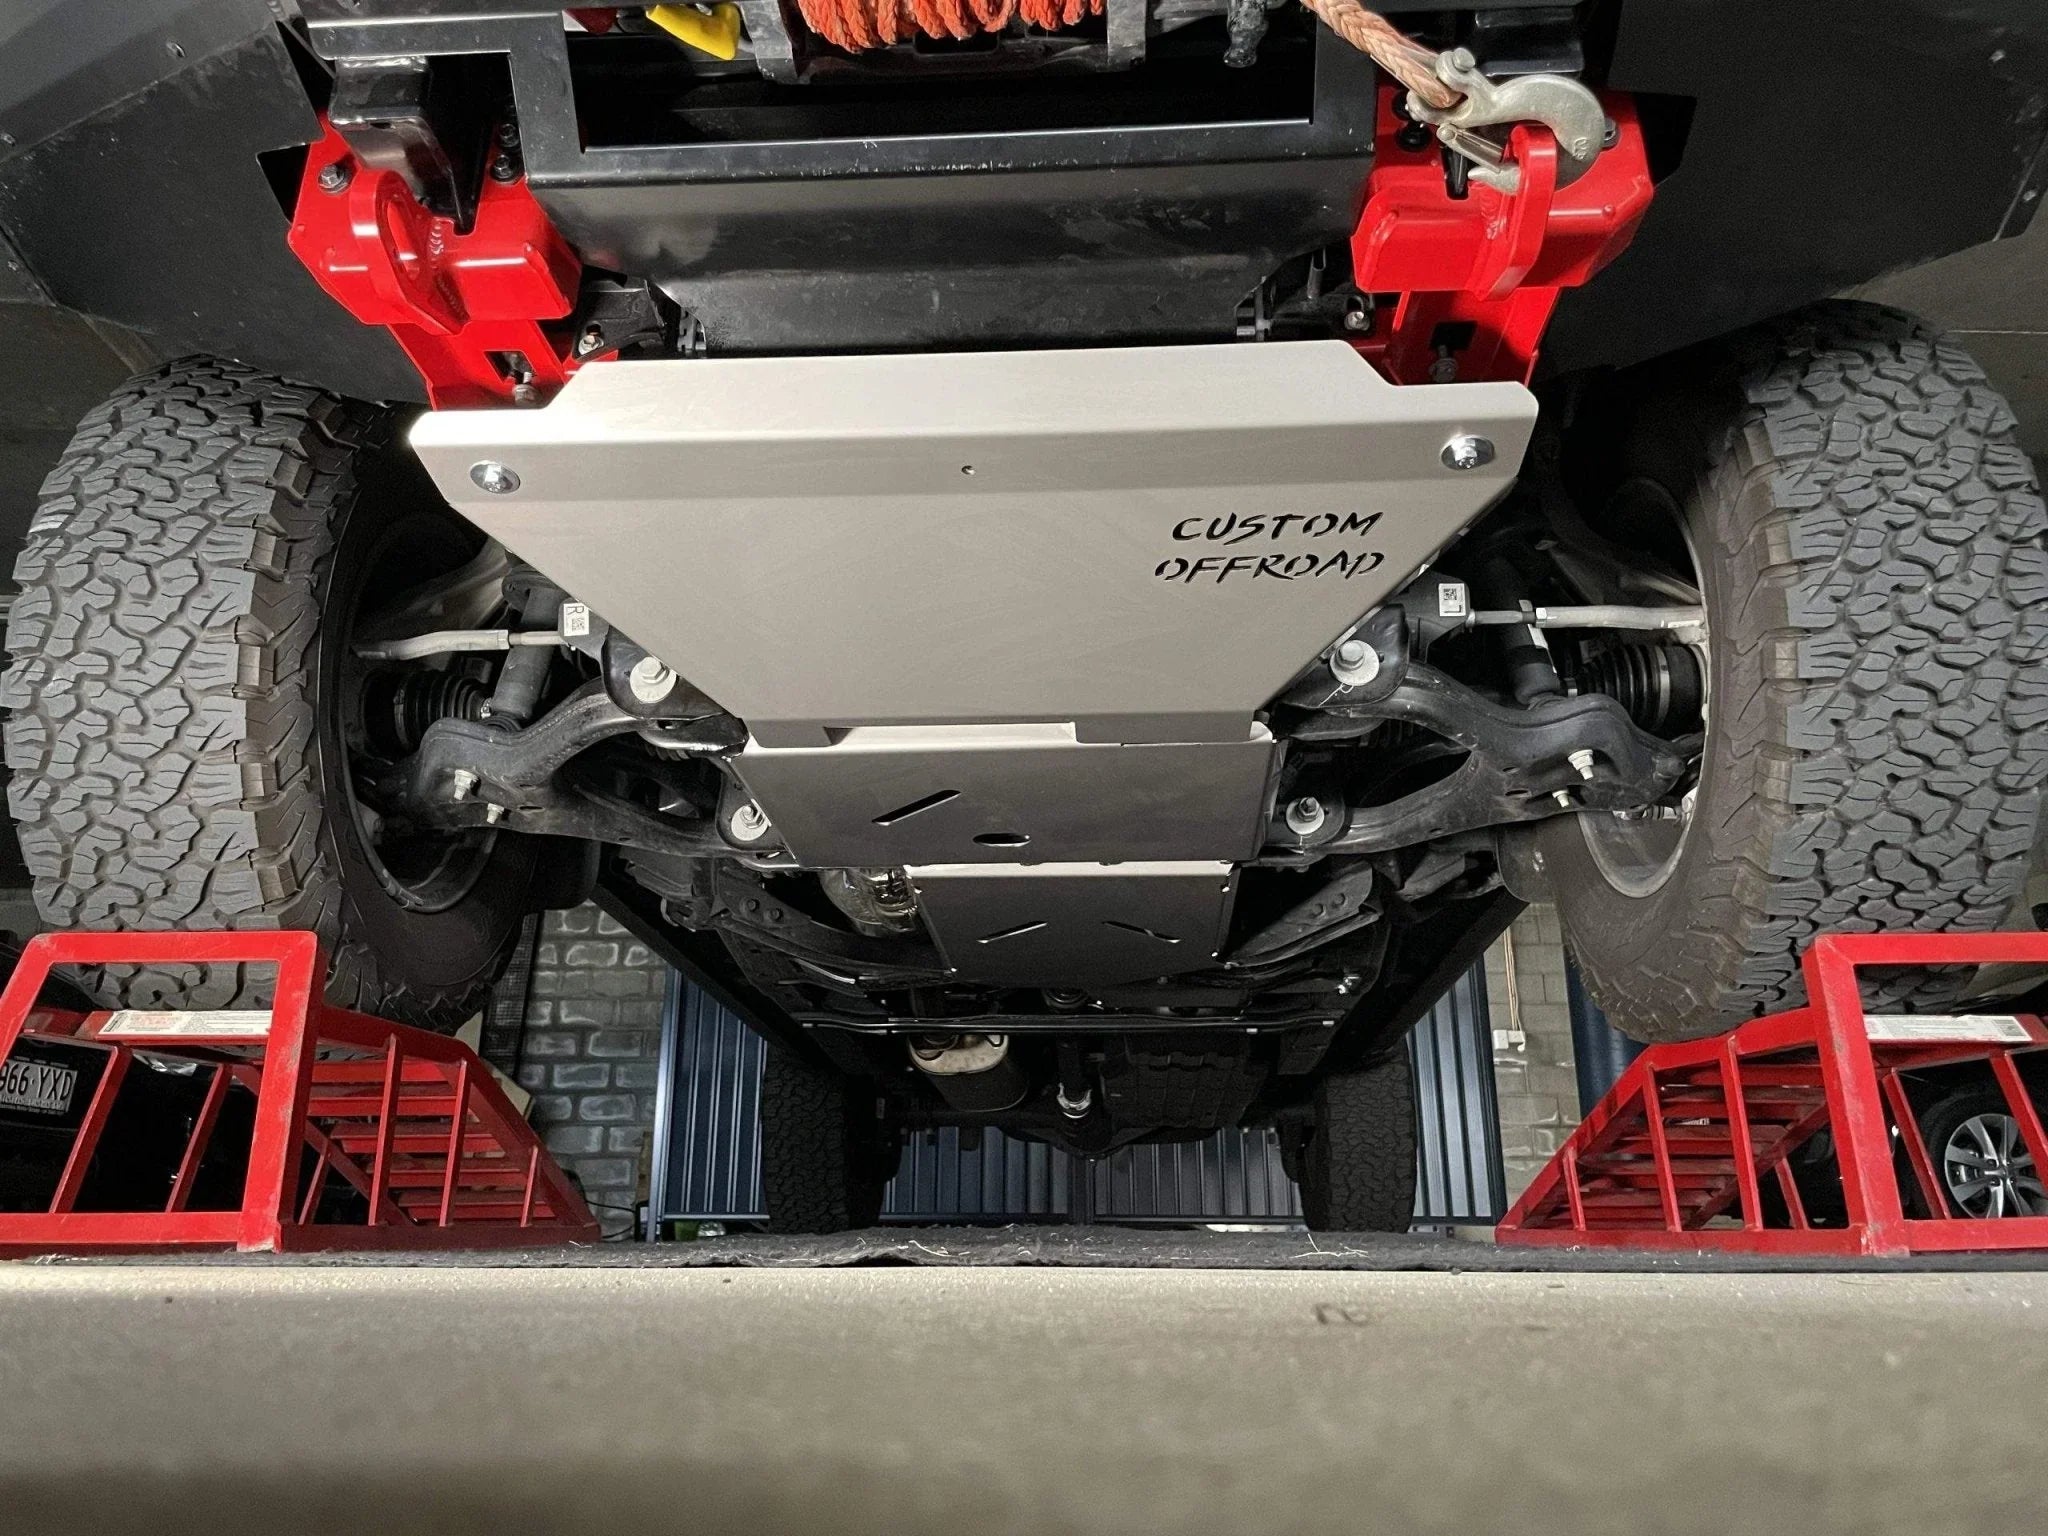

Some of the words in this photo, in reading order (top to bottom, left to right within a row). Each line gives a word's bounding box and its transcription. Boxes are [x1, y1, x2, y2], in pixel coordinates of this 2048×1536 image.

[1172, 511, 1384, 546] CUSTOM
[1155, 549, 1385, 584] OFFROAD
[567, 605, 585, 615] R
[1443, 604, 1462, 614] L
